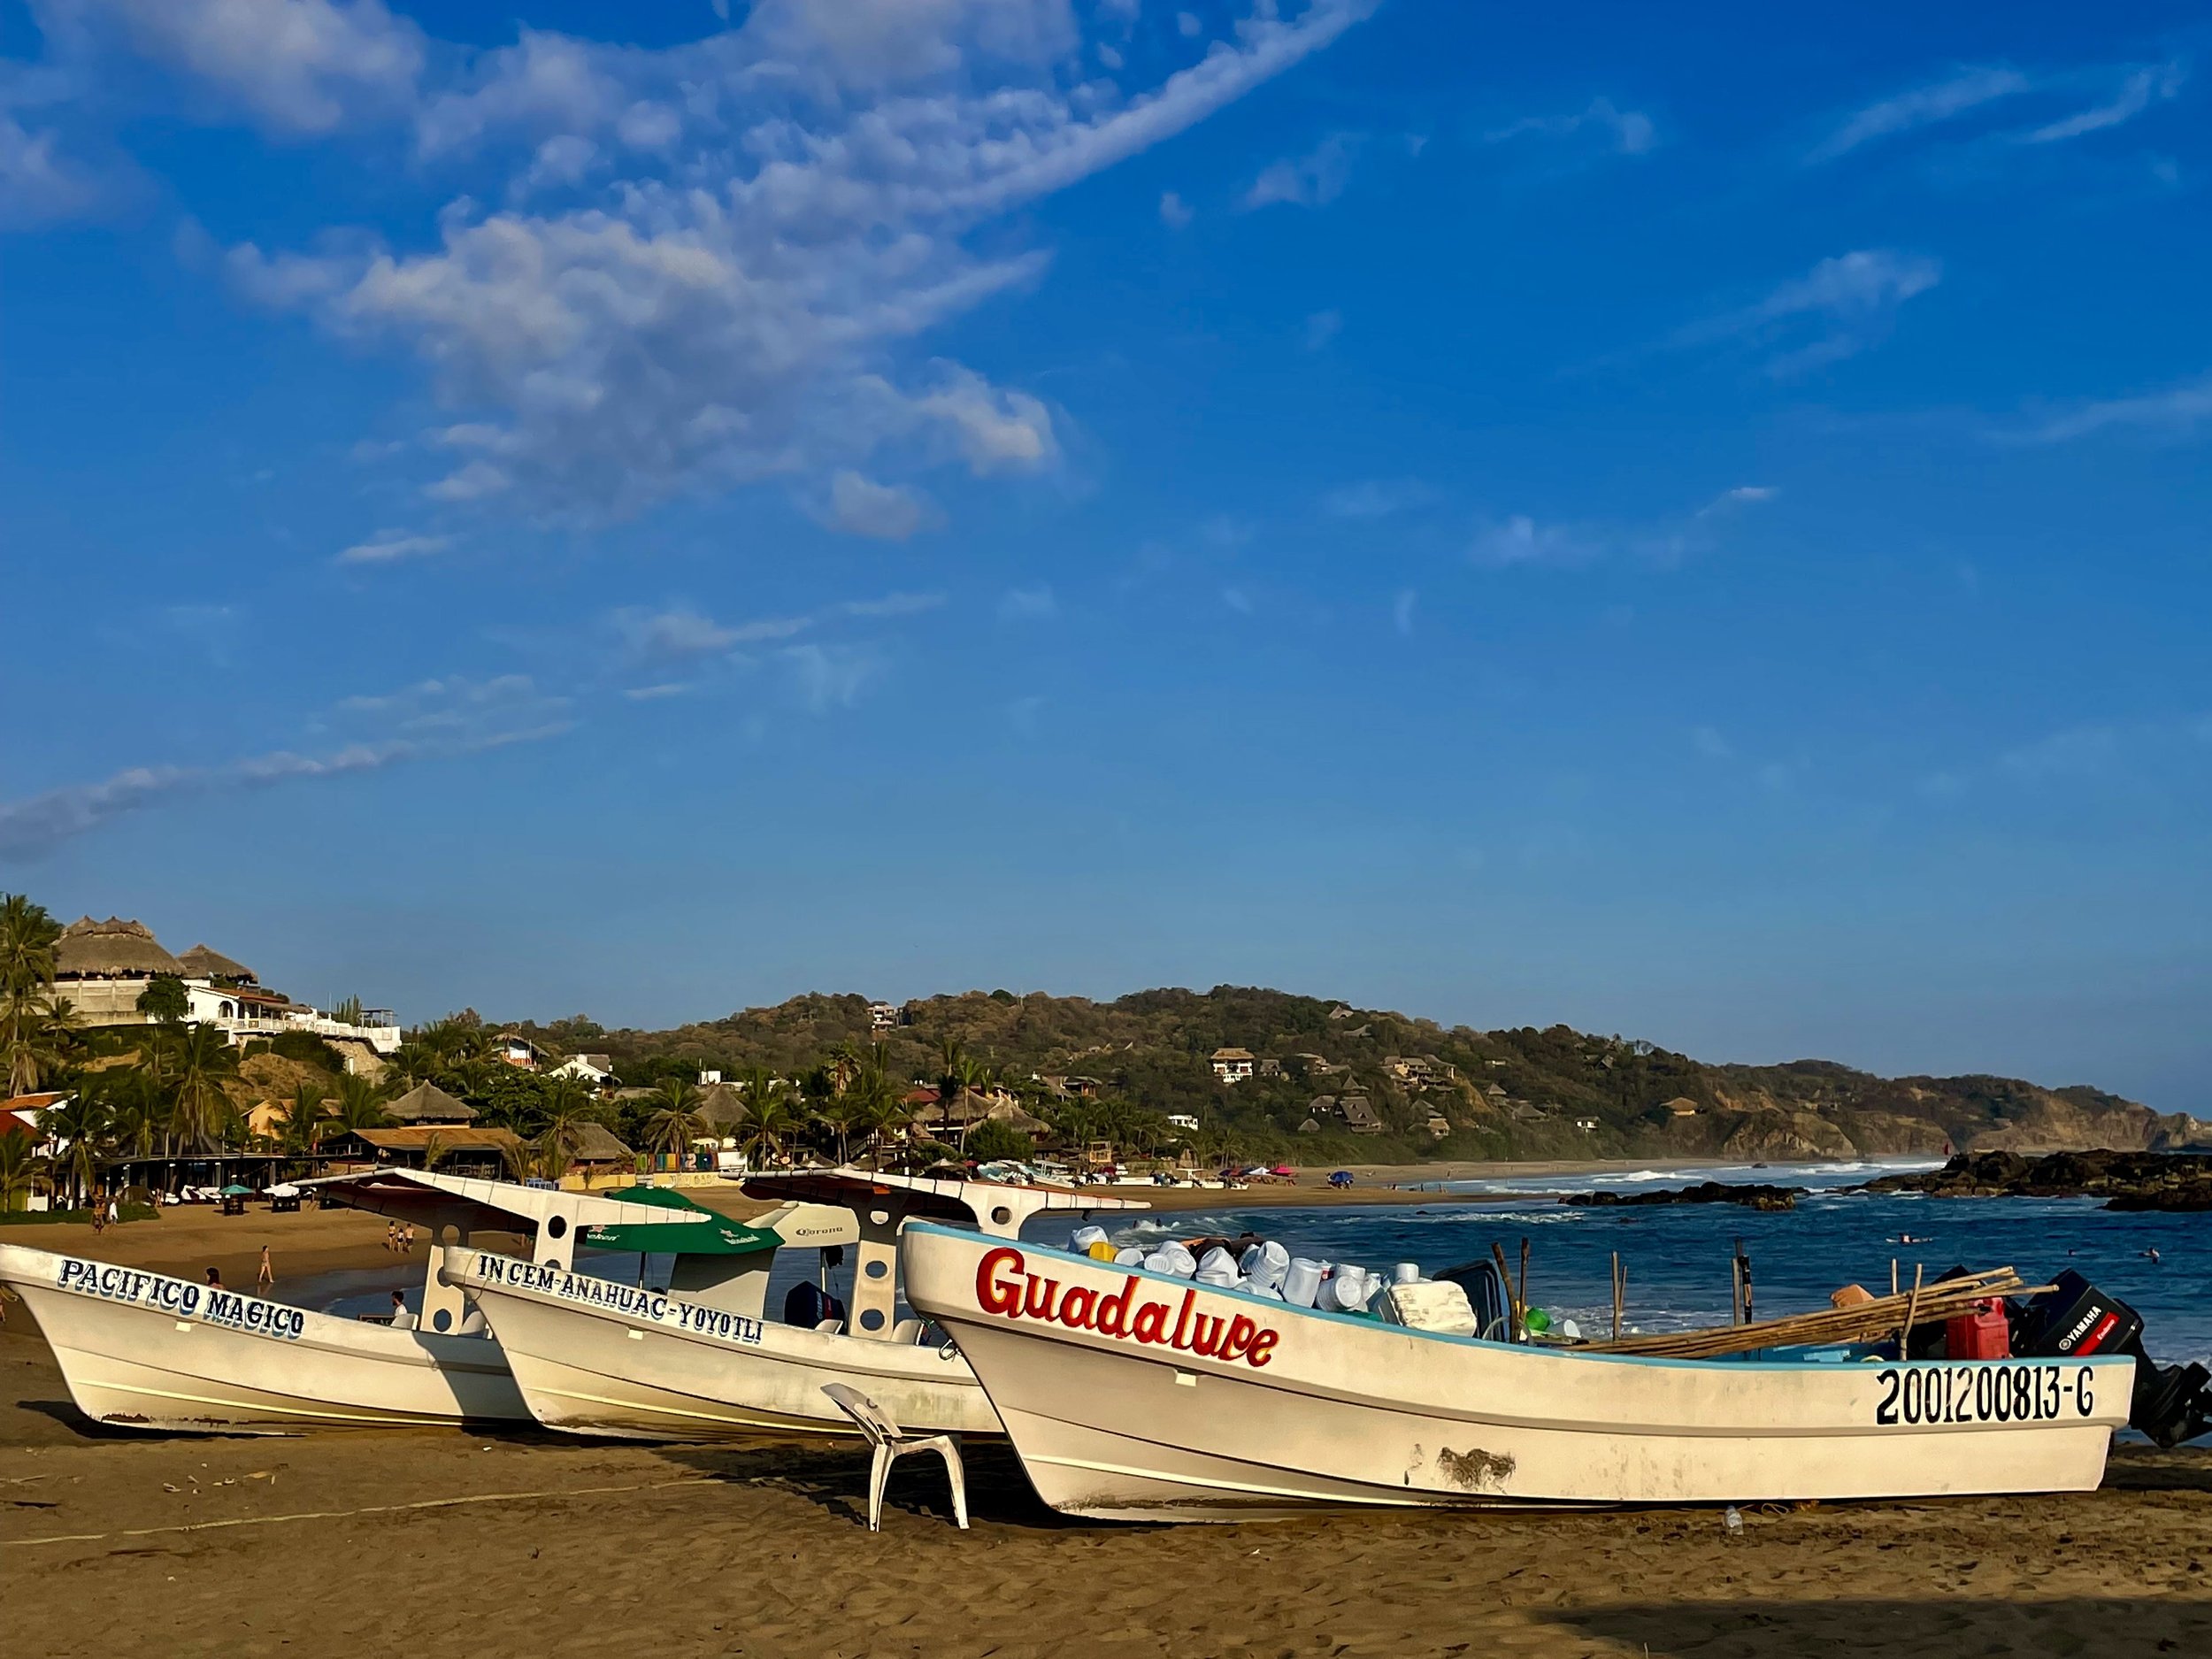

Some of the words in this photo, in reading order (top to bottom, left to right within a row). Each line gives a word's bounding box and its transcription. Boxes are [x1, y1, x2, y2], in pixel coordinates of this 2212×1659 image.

[795, 1226, 843, 1237] Corona
[478, 1255, 504, 1282] IN
[58, 1259, 200, 1315] PACIFICO
[204, 1290, 305, 1340] MAGICO
[975, 1247, 1279, 1368] Guadalupe
[2067, 1305, 2102, 1341] YAMAHA
[1876, 1365, 2094, 1425] 2001200813-G
